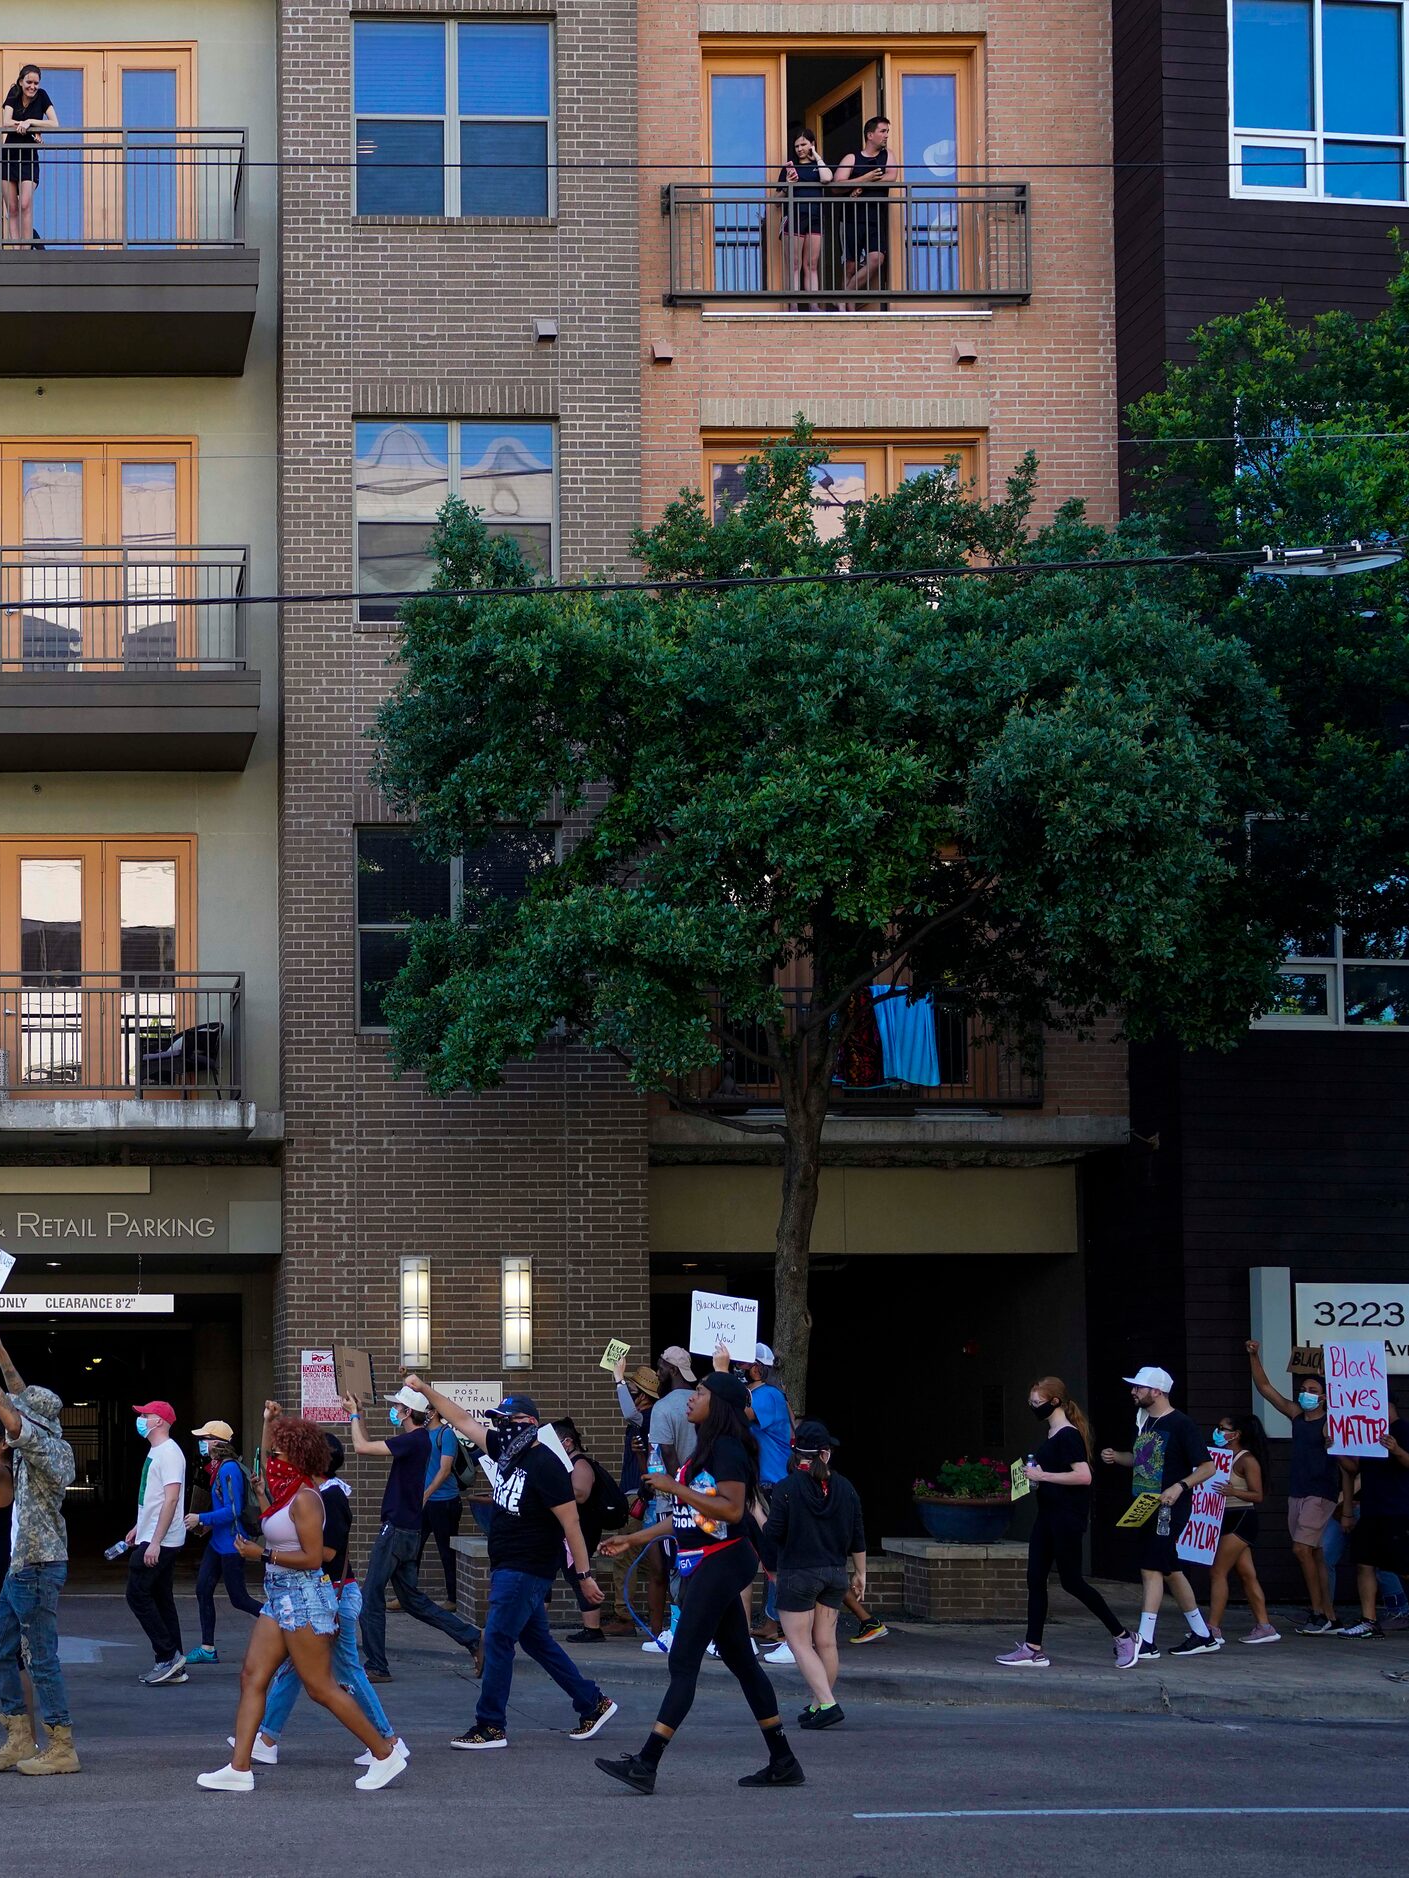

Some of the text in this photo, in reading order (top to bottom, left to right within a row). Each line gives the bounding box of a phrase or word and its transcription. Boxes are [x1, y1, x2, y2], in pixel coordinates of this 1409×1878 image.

[45, 1297, 114, 1309] CLEARANCE
[1313, 1301, 1406, 1327] 3223
[705, 1315, 736, 1331] Justice
[715, 1333, 736, 1344] Now!
[1329, 1345, 1385, 1381] Black
[455, 1388, 479, 1396] POST
[1328, 1382, 1381, 1411] Lives
[1328, 1414, 1388, 1449] MATTER
[1211, 1451, 1233, 1474] TICE
[1192, 1491, 1226, 1521] REONNA
[1181, 1520, 1220, 1553] AYLOR
